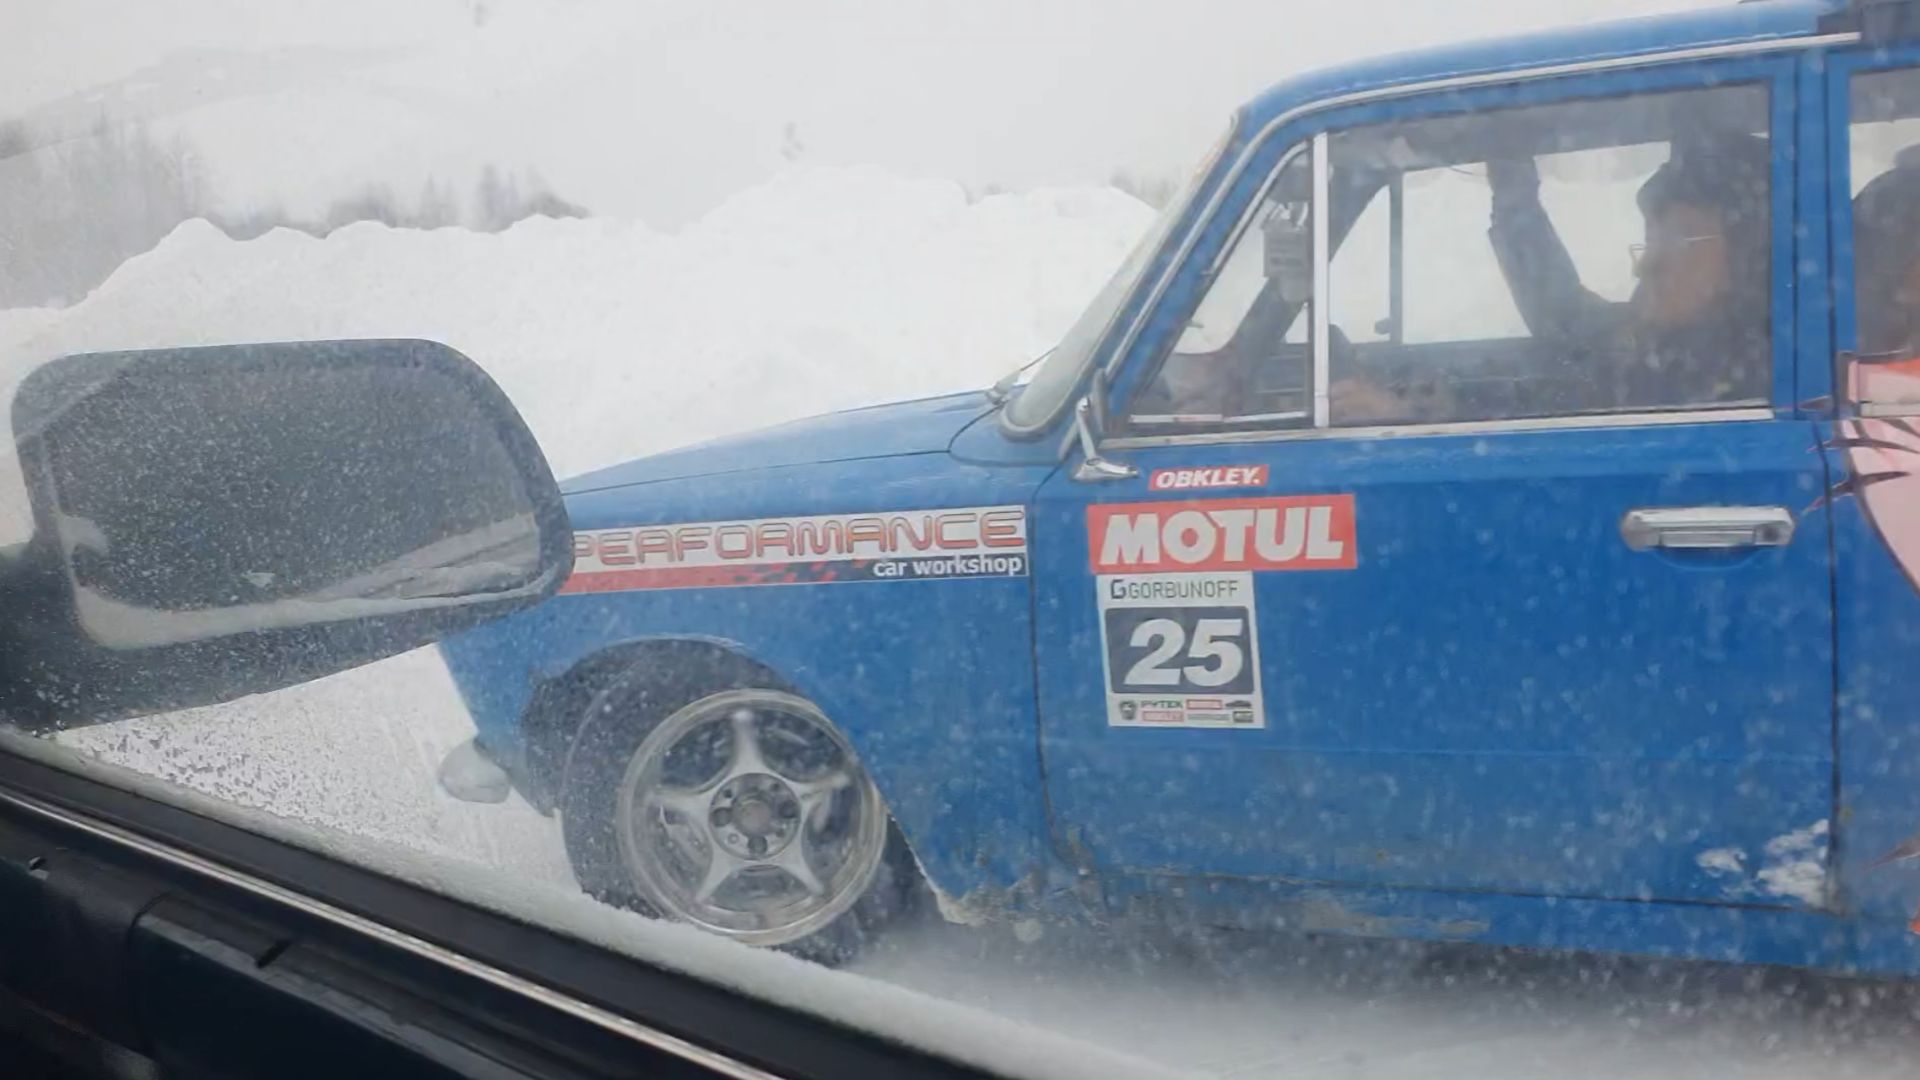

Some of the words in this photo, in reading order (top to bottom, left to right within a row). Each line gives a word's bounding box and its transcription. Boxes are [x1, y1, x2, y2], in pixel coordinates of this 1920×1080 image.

[873, 561, 904, 577] car
[912, 554, 1022, 577] workshop
[1099, 506, 1343, 566] MOTUL
[1123, 618, 1243, 687] 25
